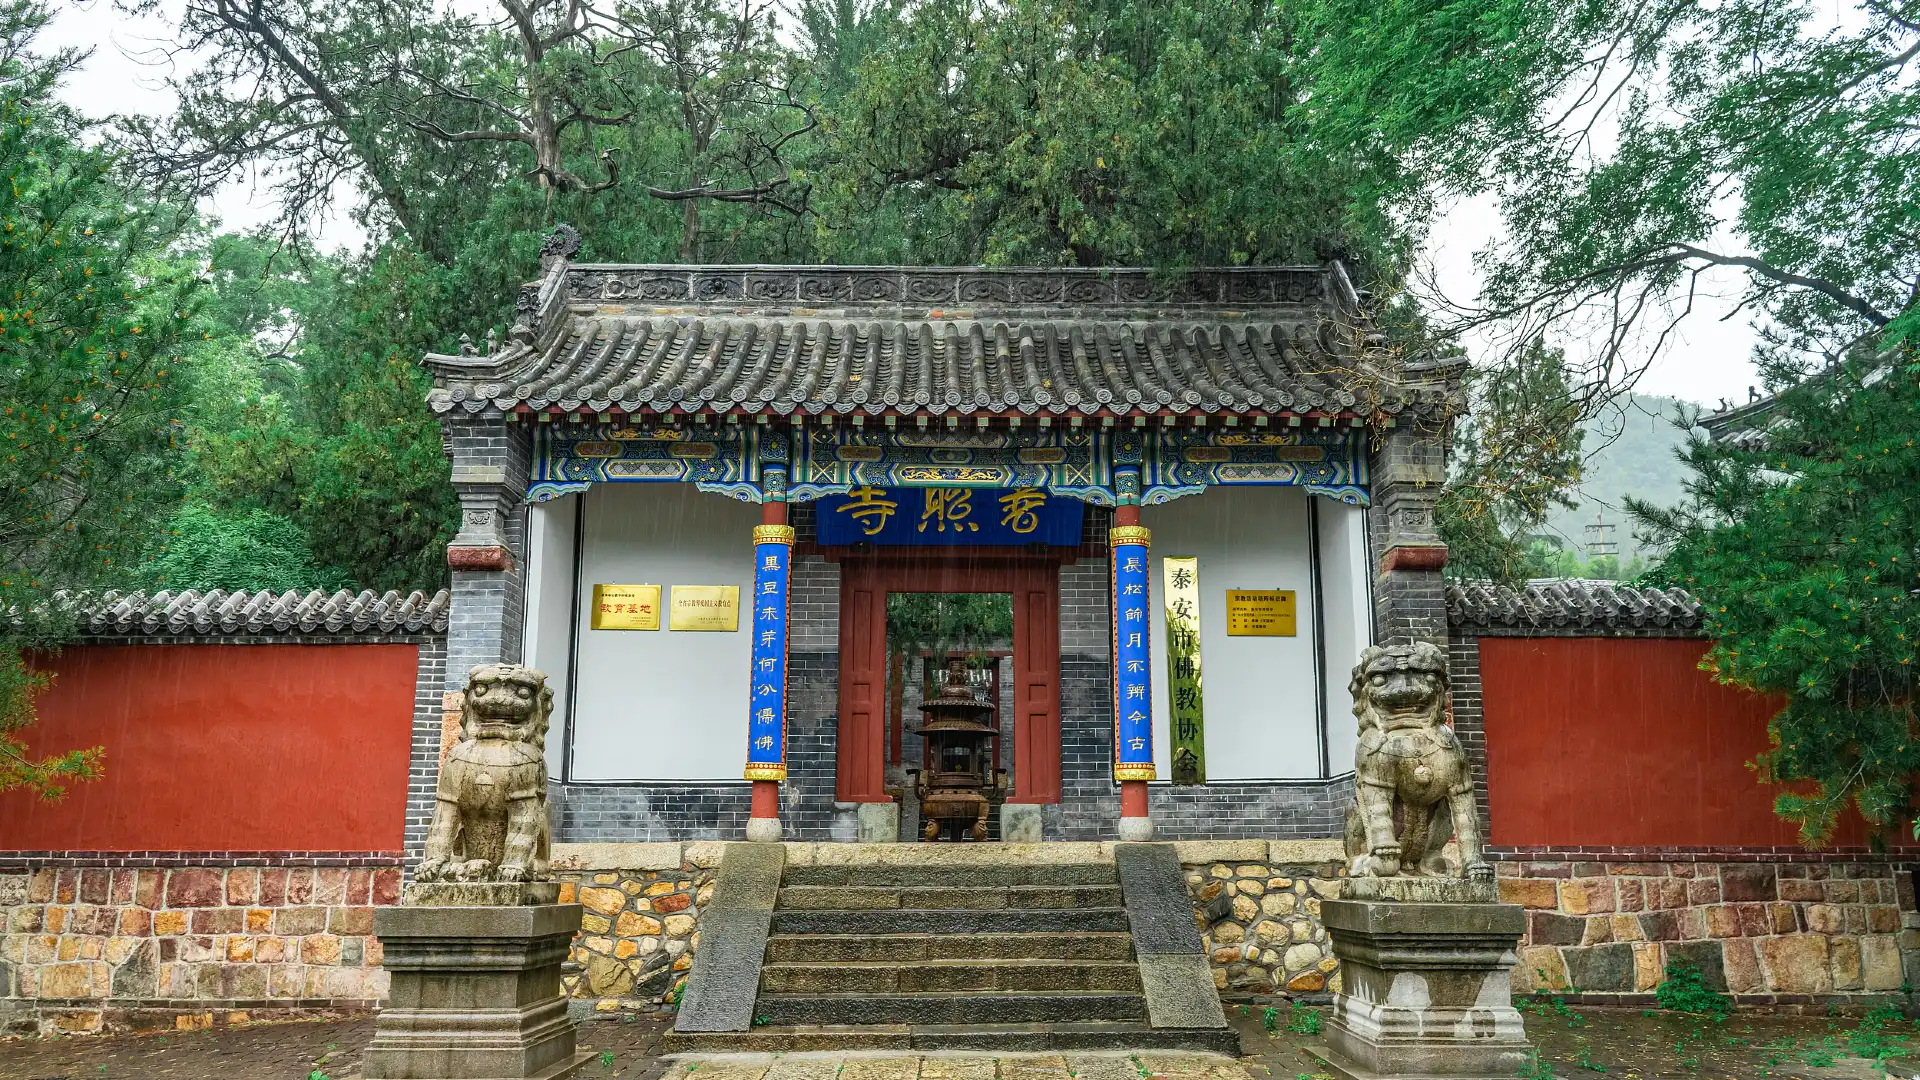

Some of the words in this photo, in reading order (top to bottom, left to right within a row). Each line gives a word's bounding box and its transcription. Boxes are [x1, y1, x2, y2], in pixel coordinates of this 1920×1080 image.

[600, 603, 652, 614] 教育基地
[1170, 567, 1199, 774] 泰安市佛教协会
